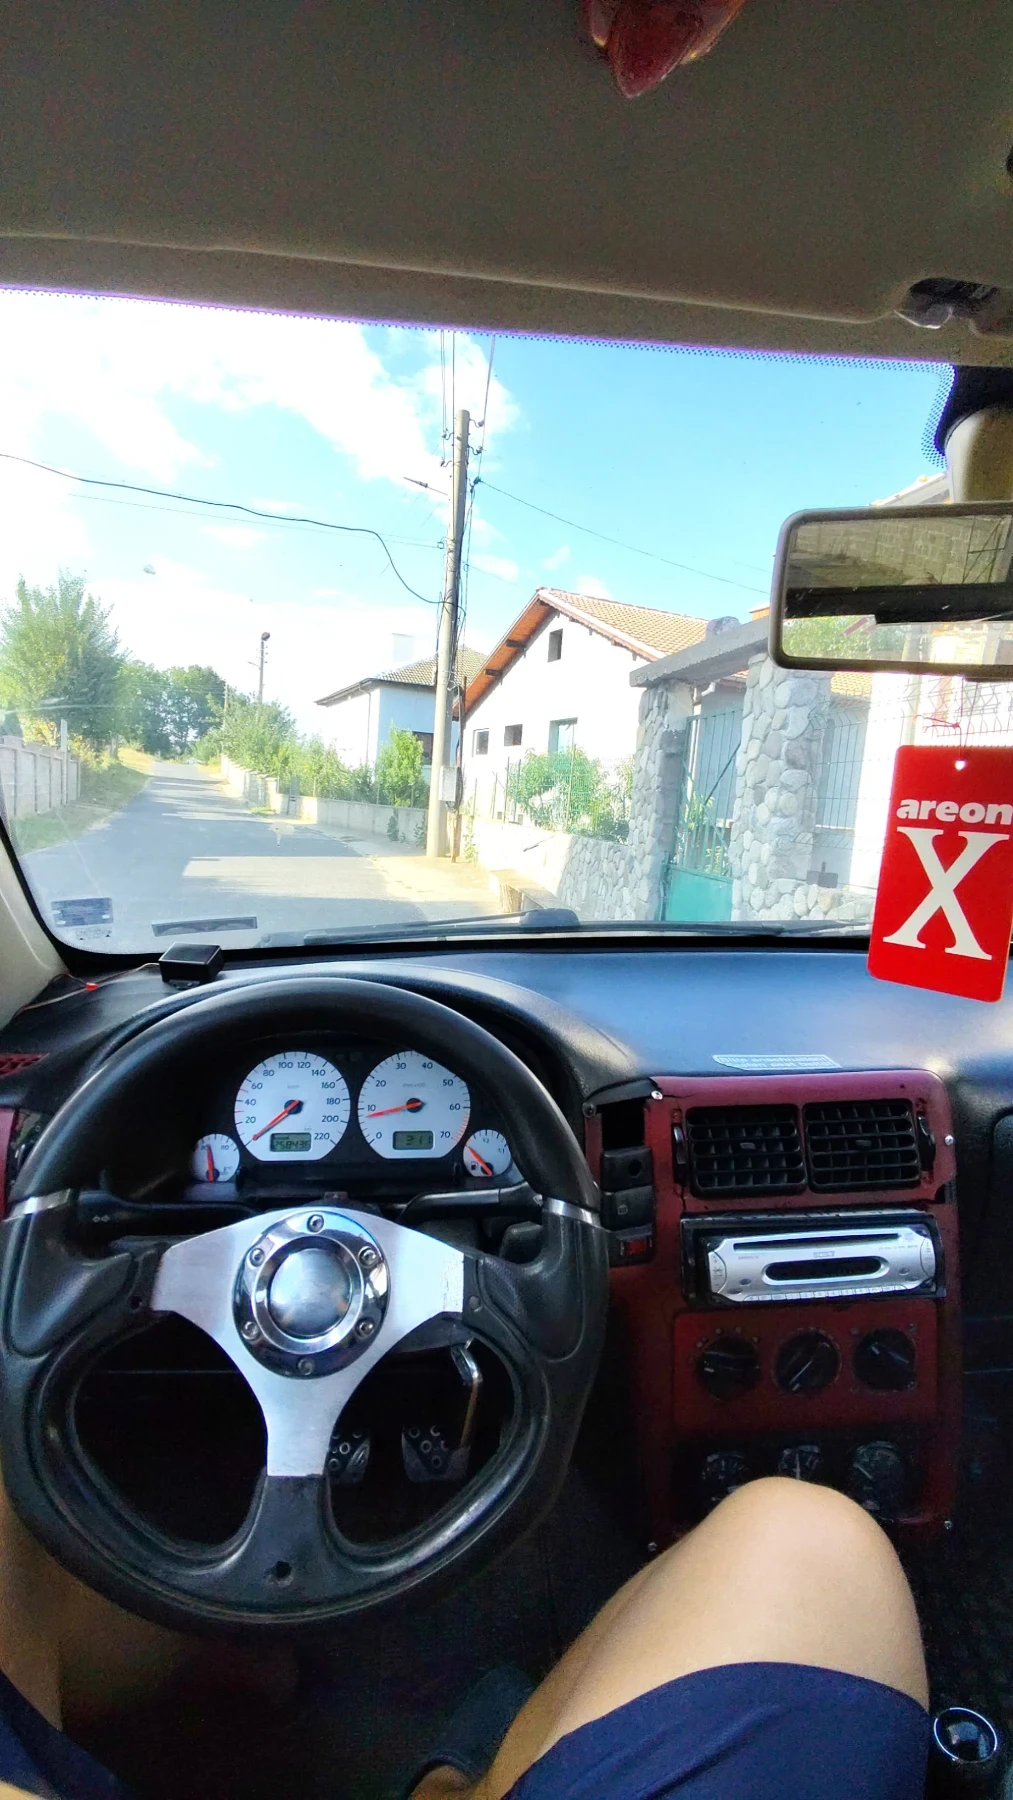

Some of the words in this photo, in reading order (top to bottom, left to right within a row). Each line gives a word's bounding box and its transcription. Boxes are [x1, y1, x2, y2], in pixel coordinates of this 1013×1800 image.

[896, 799, 1013, 825] areon
[882, 826, 1010, 960] X
[278, 1061, 293, 1069] 100
[297, 1061, 311, 1069] 120
[395, 1062, 407, 1070] 30
[421, 1061, 433, 1069] 40
[262, 1069, 275, 1077] 80
[311, 1069, 326, 1077] 140
[251, 1082, 263, 1090] 60
[321, 1081, 336, 1089] 160
[375, 1079, 387, 1087] 20
[442, 1078, 454, 1087] 50
[244, 1098, 257, 1106] 40
[326, 1097, 341, 1105] 180
[449, 1103, 461, 1111] 60
[245, 1116, 257, 1124] 20
[321, 1115, 339, 1123] 200
[314, 1132, 330, 1140] 220
[375, 1131, 383, 1139] 0
